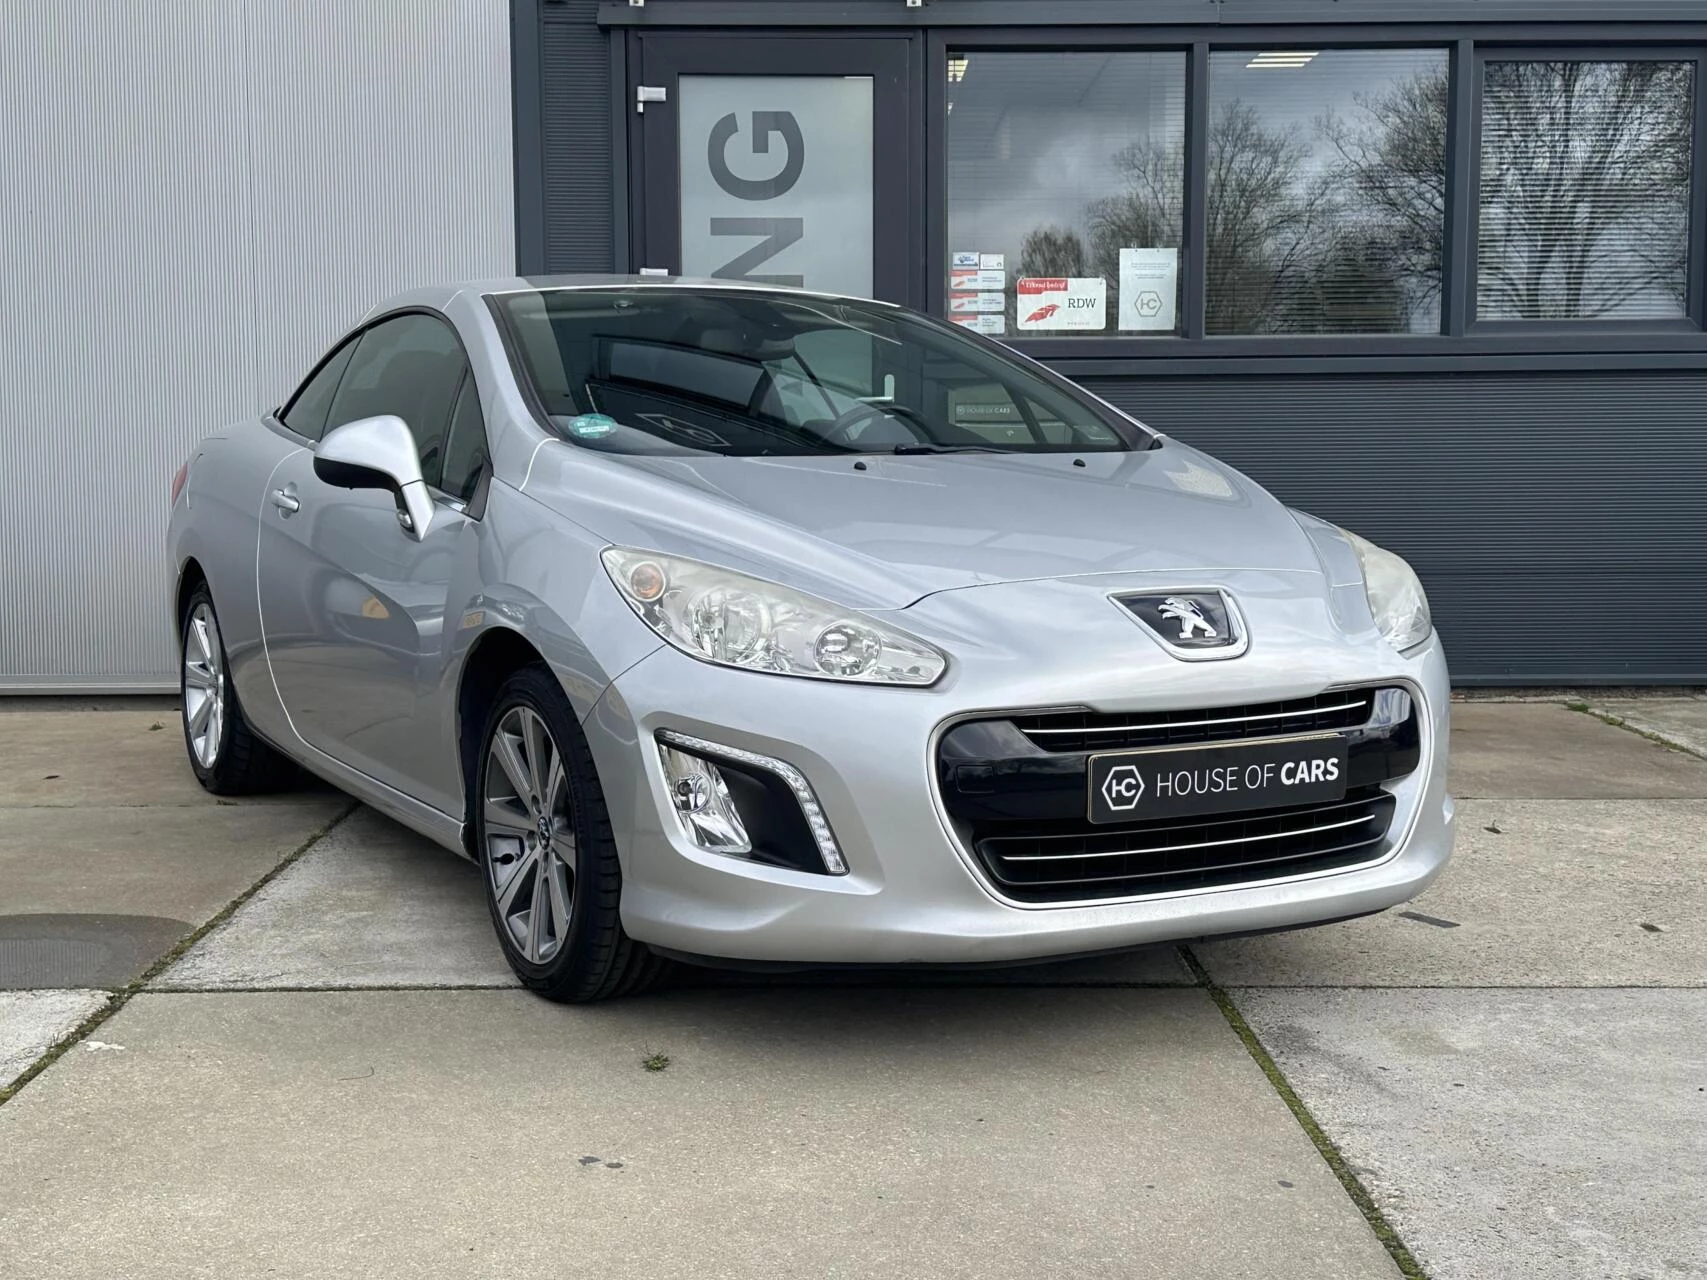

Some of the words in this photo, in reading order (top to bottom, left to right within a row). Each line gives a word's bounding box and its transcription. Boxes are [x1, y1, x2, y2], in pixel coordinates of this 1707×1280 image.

[1067, 298, 1096, 308] RDW
[1156, 766, 1239, 797] HOUSE
[1245, 763, 1276, 789] OF
[1280, 757, 1339, 785] CARS
